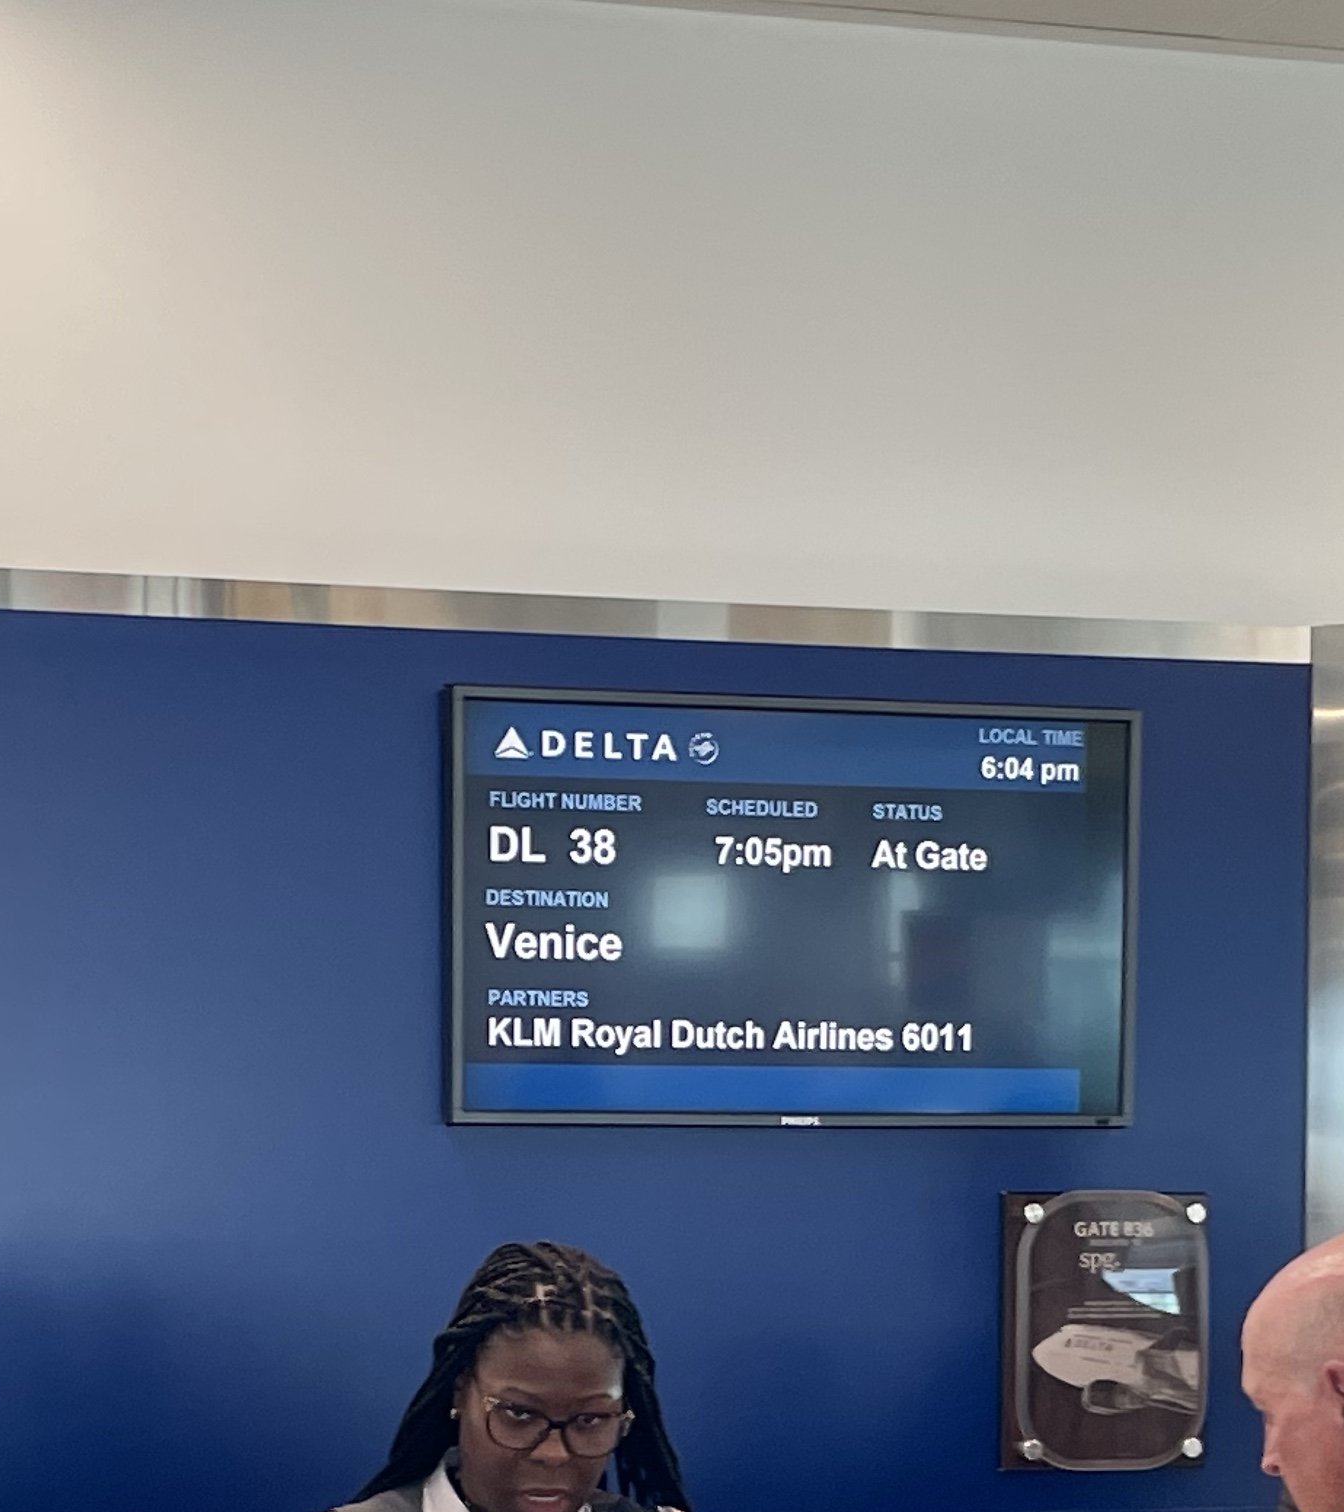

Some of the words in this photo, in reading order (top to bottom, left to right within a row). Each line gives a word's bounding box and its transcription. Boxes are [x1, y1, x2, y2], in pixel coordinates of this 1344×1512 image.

[540, 729, 678, 762] DELTA
[978, 728, 1039, 746] LOCAL
[1041, 729, 1085, 748] TIME
[981, 755, 1034, 781] 6:04
[1040, 762, 1080, 786] pm
[488, 790, 558, 810] FLIGHT
[560, 793, 643, 812] NUMBER
[705, 798, 819, 819] SCHEDULED
[872, 802, 944, 822] STATUS
[488, 825, 547, 863] DL
[568, 828, 617, 866] 38
[714, 835, 832, 874] 7:05pm
[870, 839, 908, 869] At
[915, 840, 988, 872] Gate
[485, 888, 609, 909] DESTINATION
[484, 922, 623, 961] Venice
[487, 988, 590, 1009] PARTNERS
[487, 1017, 561, 1047] KLM
[571, 1017, 662, 1056] Royal
[671, 1018, 765, 1051] Dutch
[772, 1020, 894, 1052] Airlines
[901, 1022, 972, 1052] 6011
[1073, 1221, 1120, 1238] GATE
